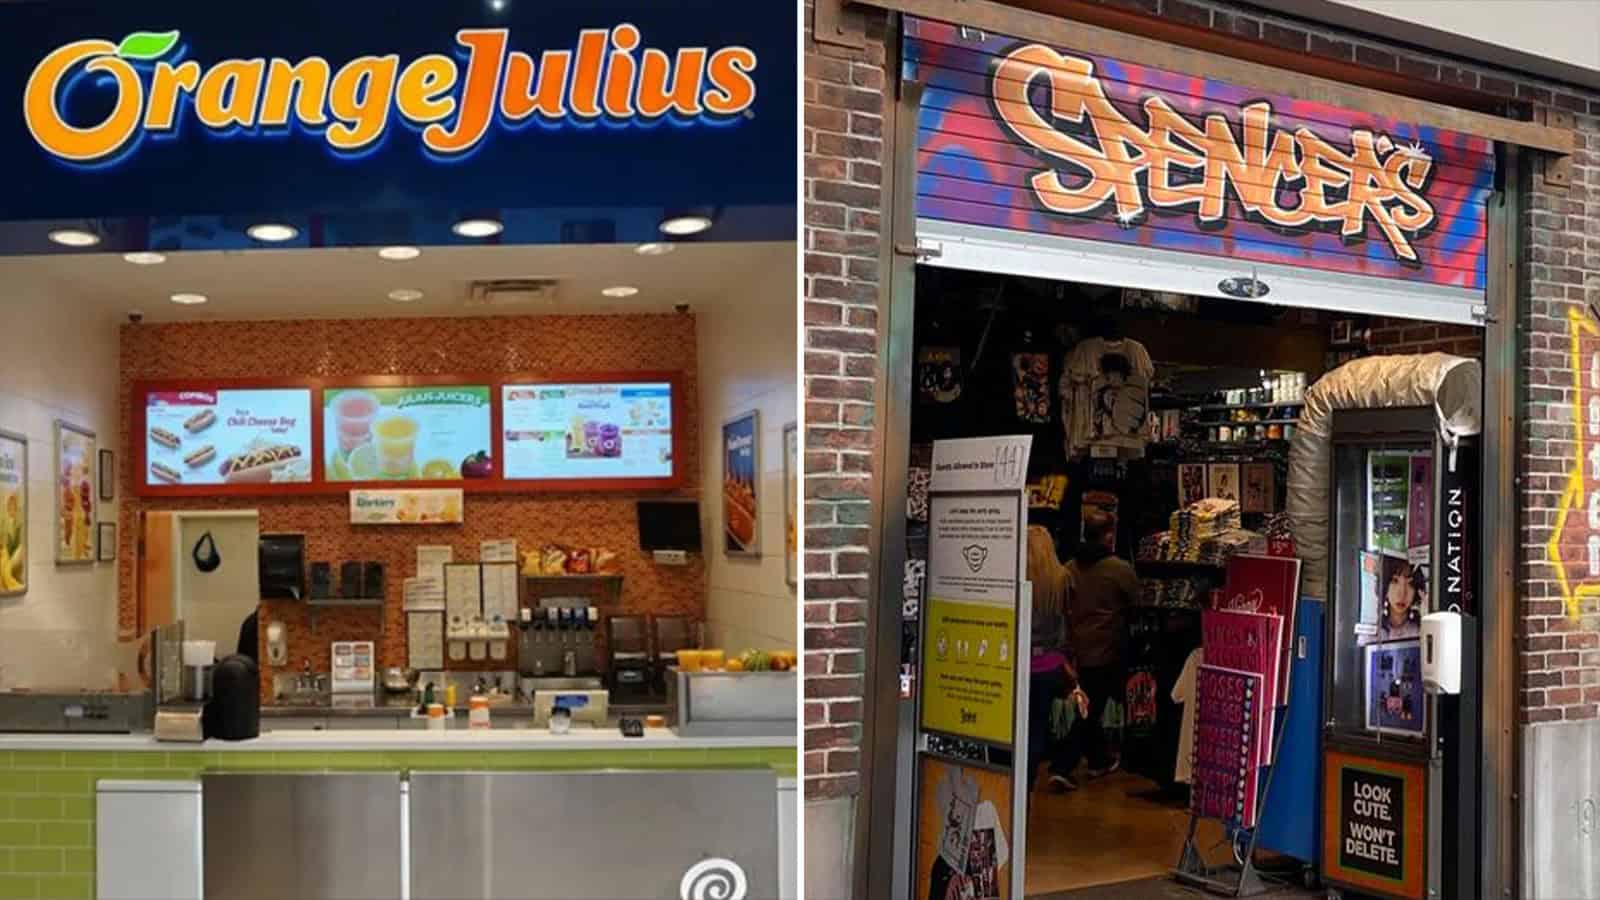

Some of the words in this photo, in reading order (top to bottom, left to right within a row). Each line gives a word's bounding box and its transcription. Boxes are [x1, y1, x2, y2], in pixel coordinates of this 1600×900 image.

[24, 39, 457, 160] Orange
[421, 24, 757, 152] Julius
[992, 44, 1435, 261] SPENCER'S
[1447, 488, 1463, 593] NATION
[1353, 780, 1392, 804] LOOK
[1353, 799, 1392, 821] CUTE.
[1349, 820, 1396, 847] WON'T
[1346, 836, 1400, 866] DELETE.
